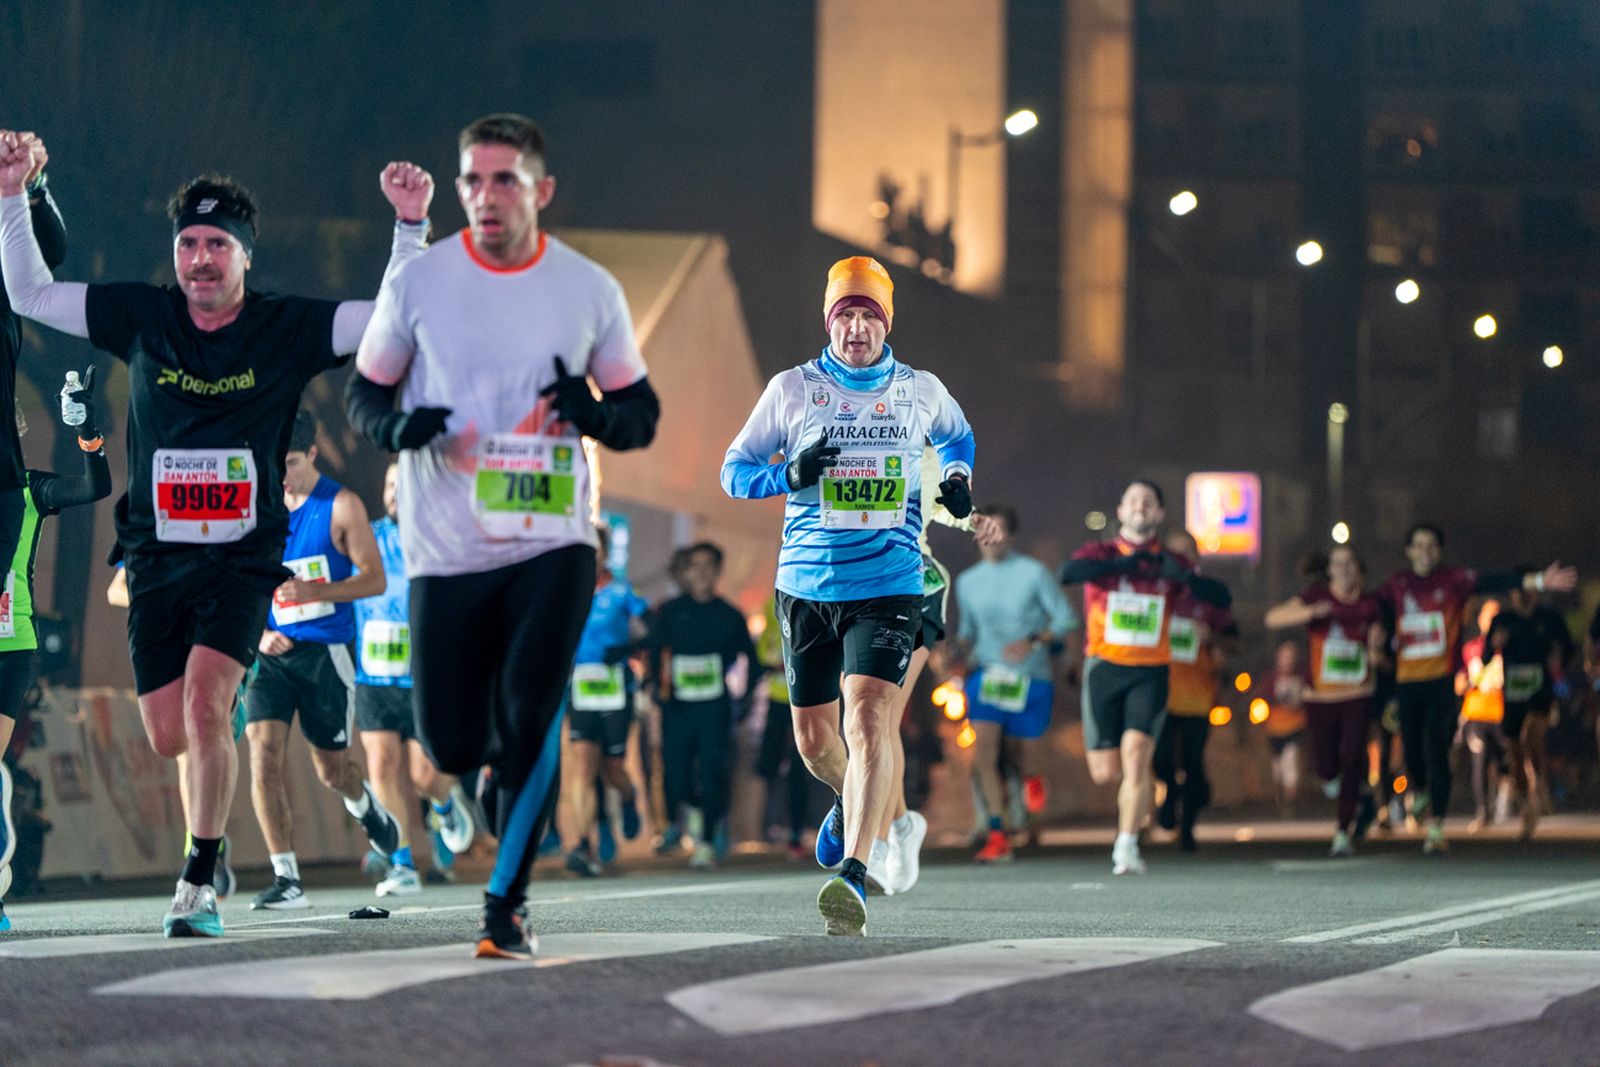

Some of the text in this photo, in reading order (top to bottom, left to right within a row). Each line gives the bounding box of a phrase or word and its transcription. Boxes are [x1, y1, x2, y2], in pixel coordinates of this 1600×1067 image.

[181, 368, 255, 395] personal
[821, 426, 907, 439] MARACENA
[174, 461, 204, 470] NOCHE
[206, 461, 217, 470] DE
[829, 469, 847, 477] SAN
[164, 472, 183, 481] SAN
[504, 472, 551, 503] 704
[833, 479, 897, 502] 13472
[172, 484, 239, 511] 9962
